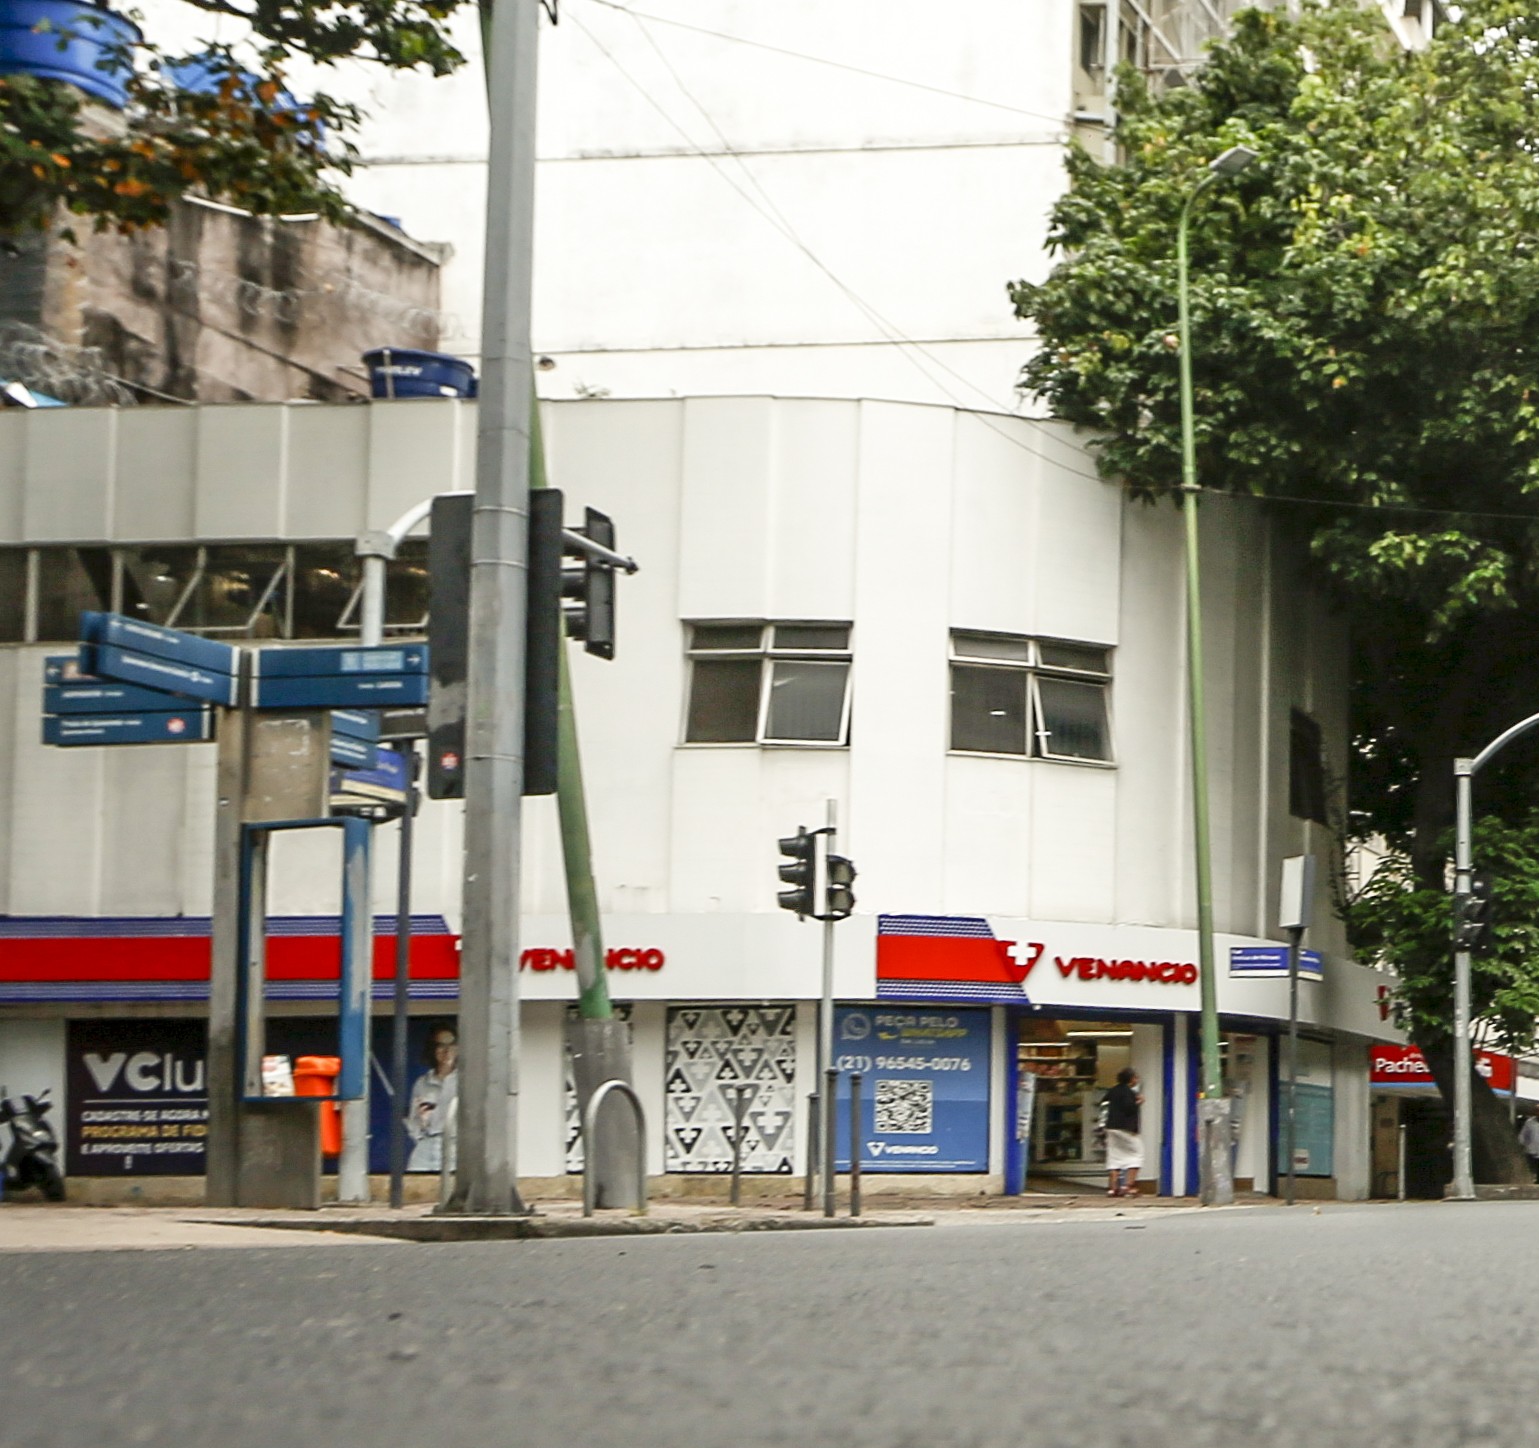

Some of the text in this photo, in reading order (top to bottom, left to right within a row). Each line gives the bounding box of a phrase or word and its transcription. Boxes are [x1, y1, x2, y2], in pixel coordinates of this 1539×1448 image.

[1055, 956, 1198, 985] VENANCIO
[919, 1016, 960, 1028] PELO
[82, 1051, 205, 1092] VClu
[836, 1055, 972, 1073] (21) 96545-0076
[1374, 1056, 1430, 1073] Pache
[82, 1125, 159, 1138] PROGRAMA
[161, 1124, 180, 1137] DE
